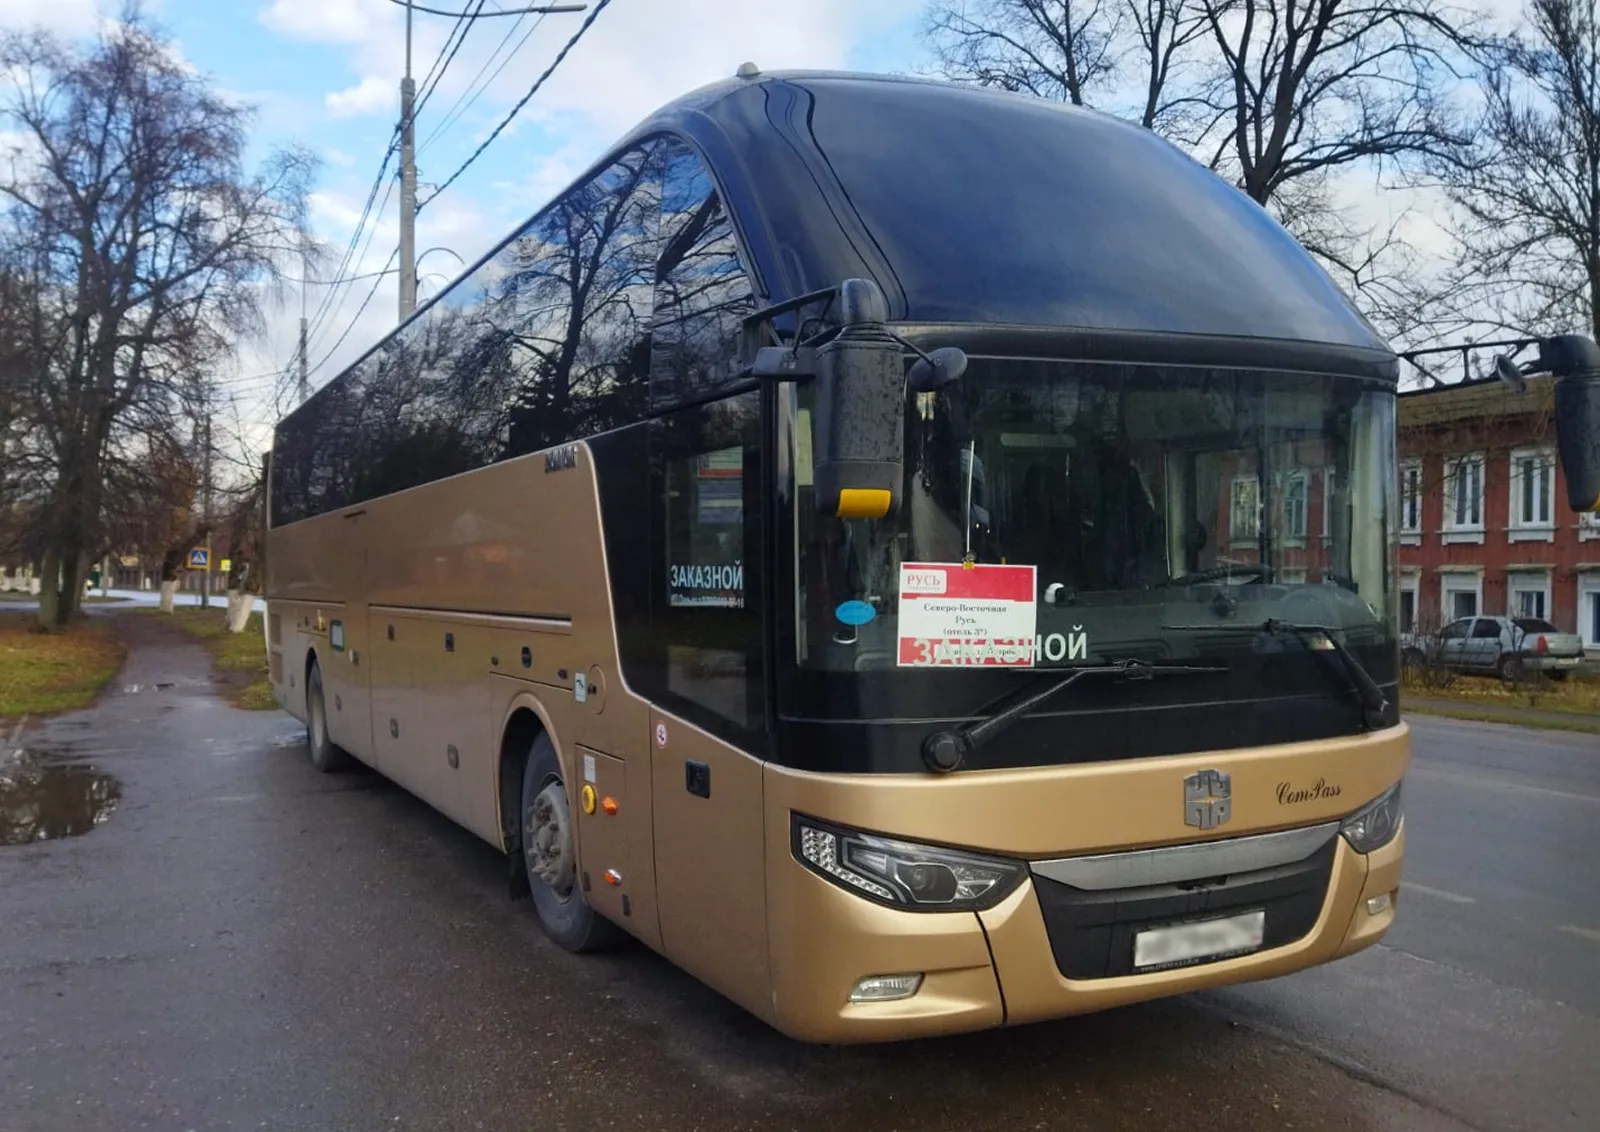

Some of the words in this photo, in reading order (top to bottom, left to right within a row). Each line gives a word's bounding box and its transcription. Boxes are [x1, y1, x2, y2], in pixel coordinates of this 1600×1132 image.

[670, 560, 743, 590] ЗАКАЗНОЙ
[907, 574, 941, 586] РУСЬ
[923, 603, 1007, 613] Северо-Восточная
[955, 615, 977, 625] Русь
[912, 624, 1087, 666] ЗАКАЗНОЙ
